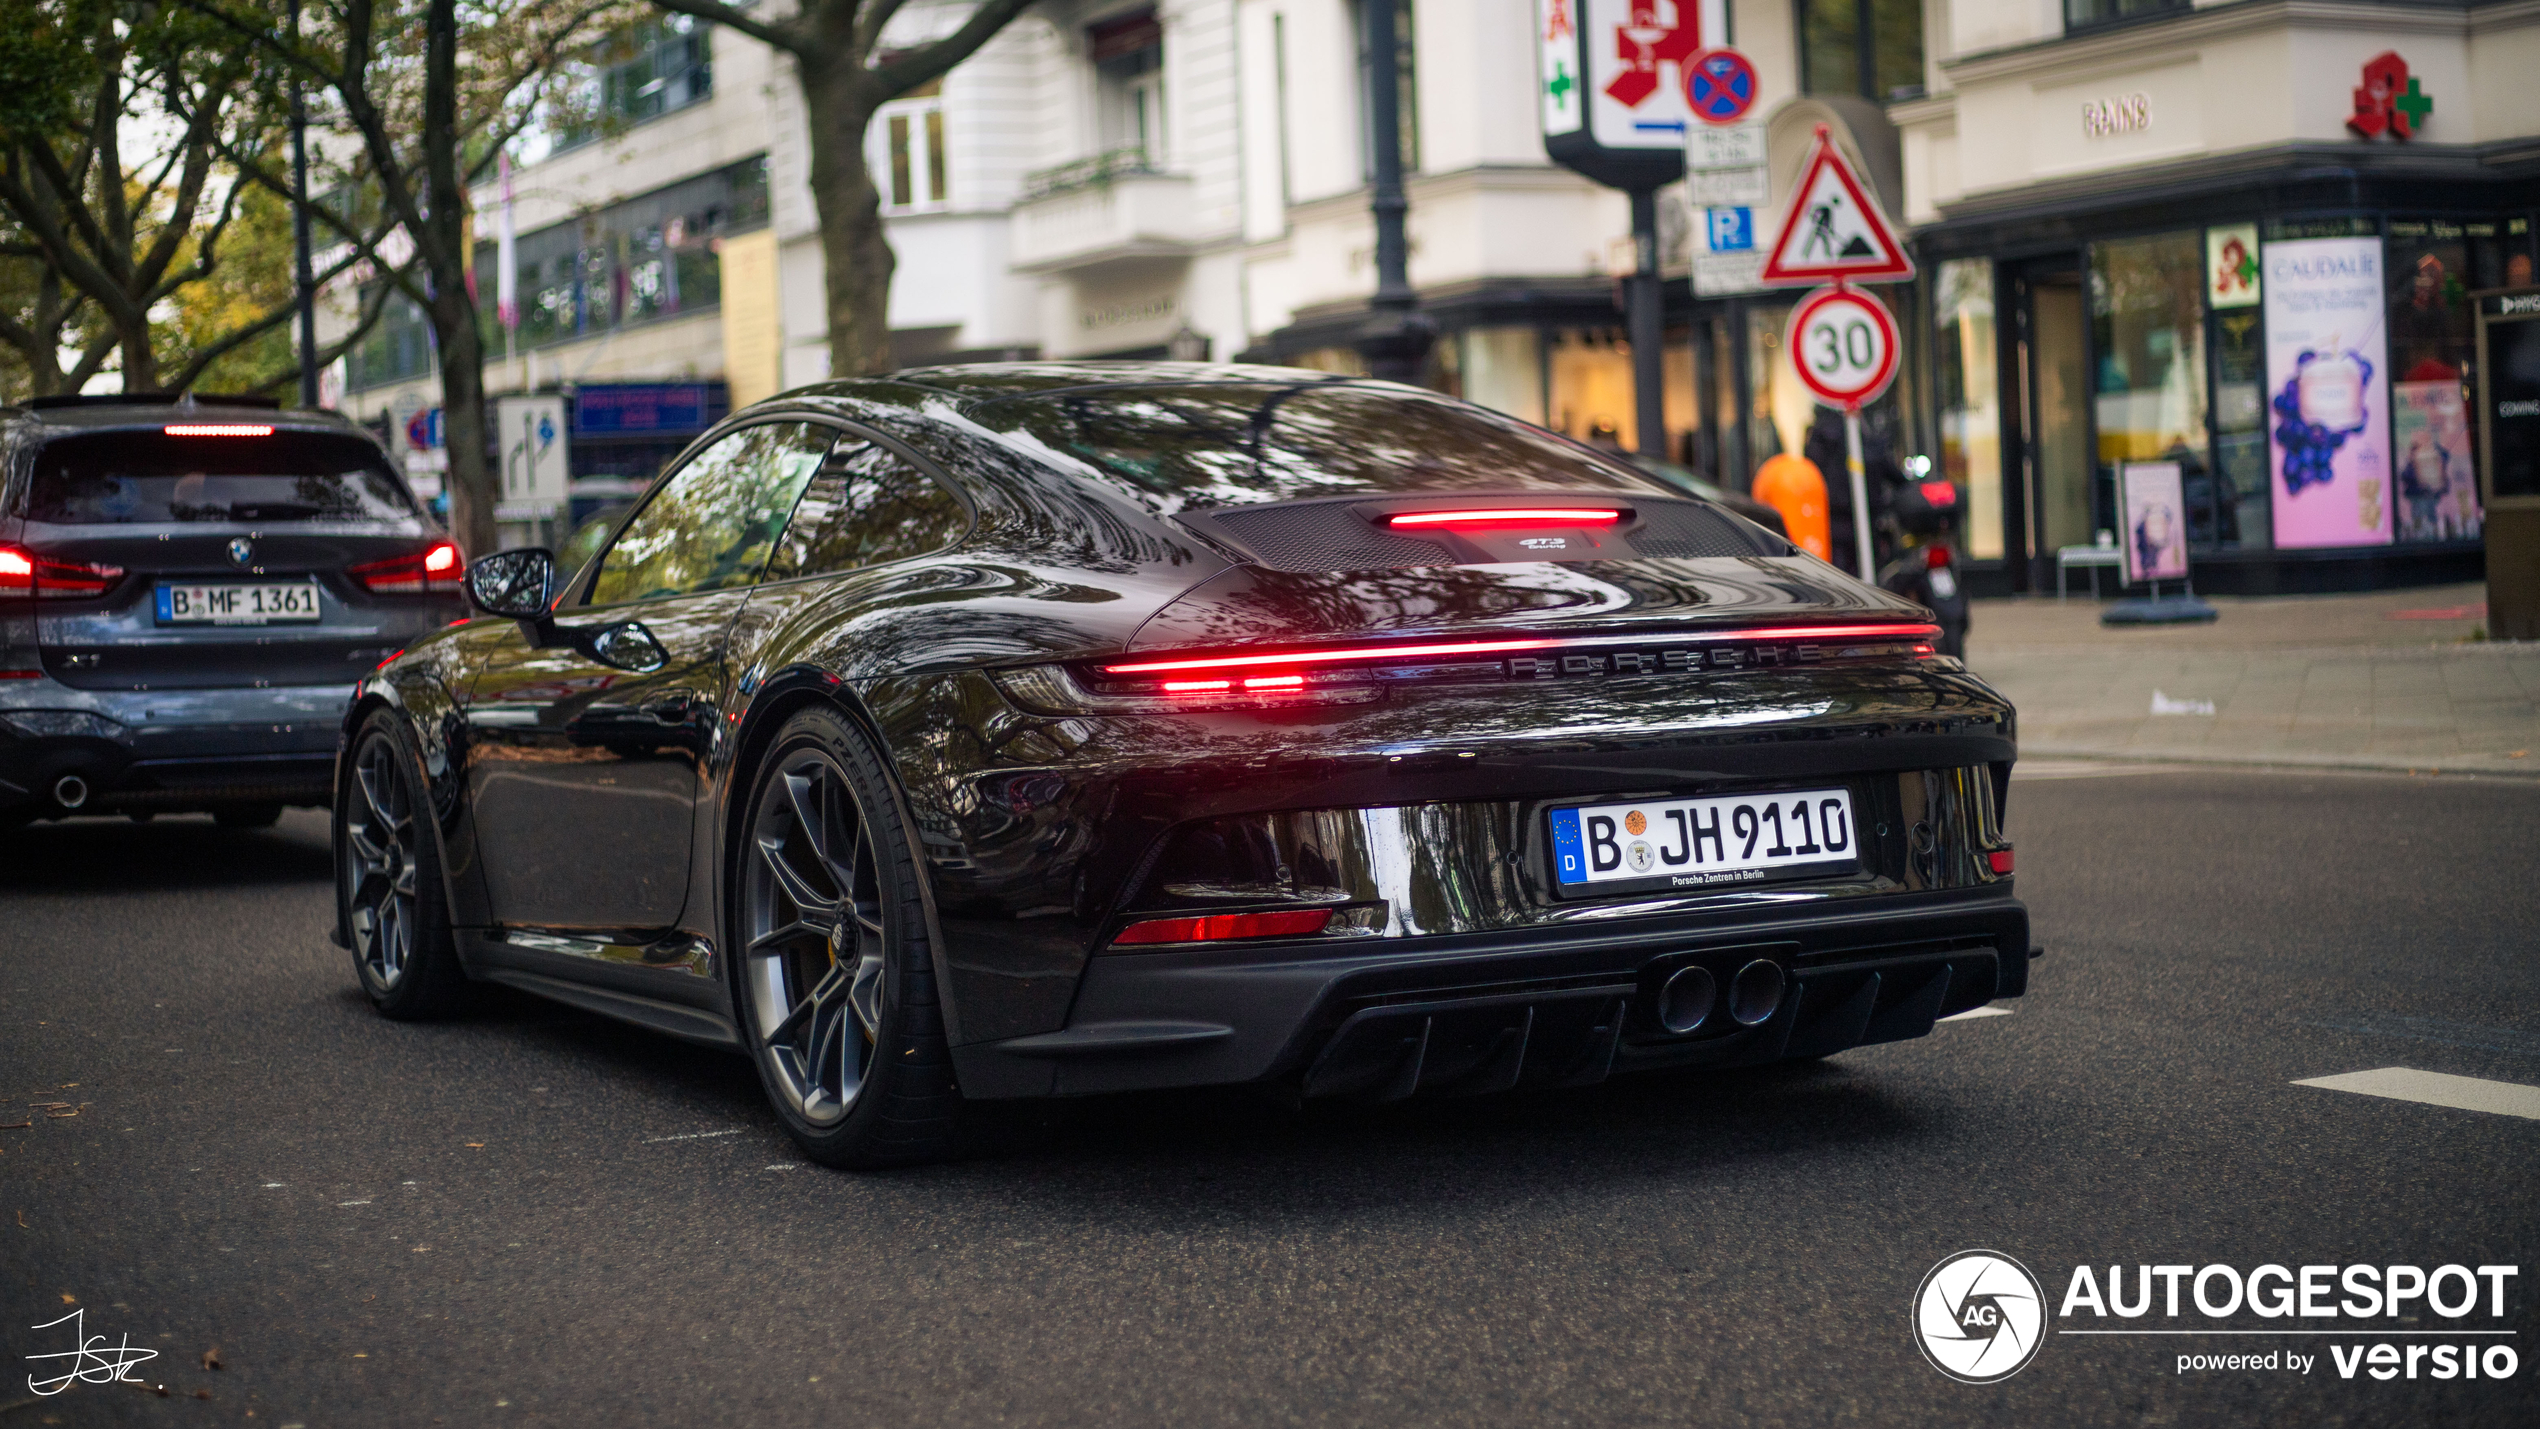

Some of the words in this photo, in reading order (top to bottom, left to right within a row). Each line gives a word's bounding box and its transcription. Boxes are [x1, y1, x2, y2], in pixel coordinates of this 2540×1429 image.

[2082, 92, 2152, 138] RAINS
[1812, 321, 1874, 374] 30
[172, 589, 190, 615] B
[209, 588, 243, 614] MF
[251, 587, 316, 613] 1361
[1508, 644, 1821, 677] PORSCHE
[1586, 815, 1622, 872] B
[1660, 806, 1725, 866] JH
[1732, 798, 1849, 860] 9110
[1563, 854, 1577, 872] D
[1671, 874, 1704, 887] Porsche
[1704, 871, 1734, 885] Zentren
[1734, 871, 1743, 882] in
[1742, 869, 1765, 881] Berlin
